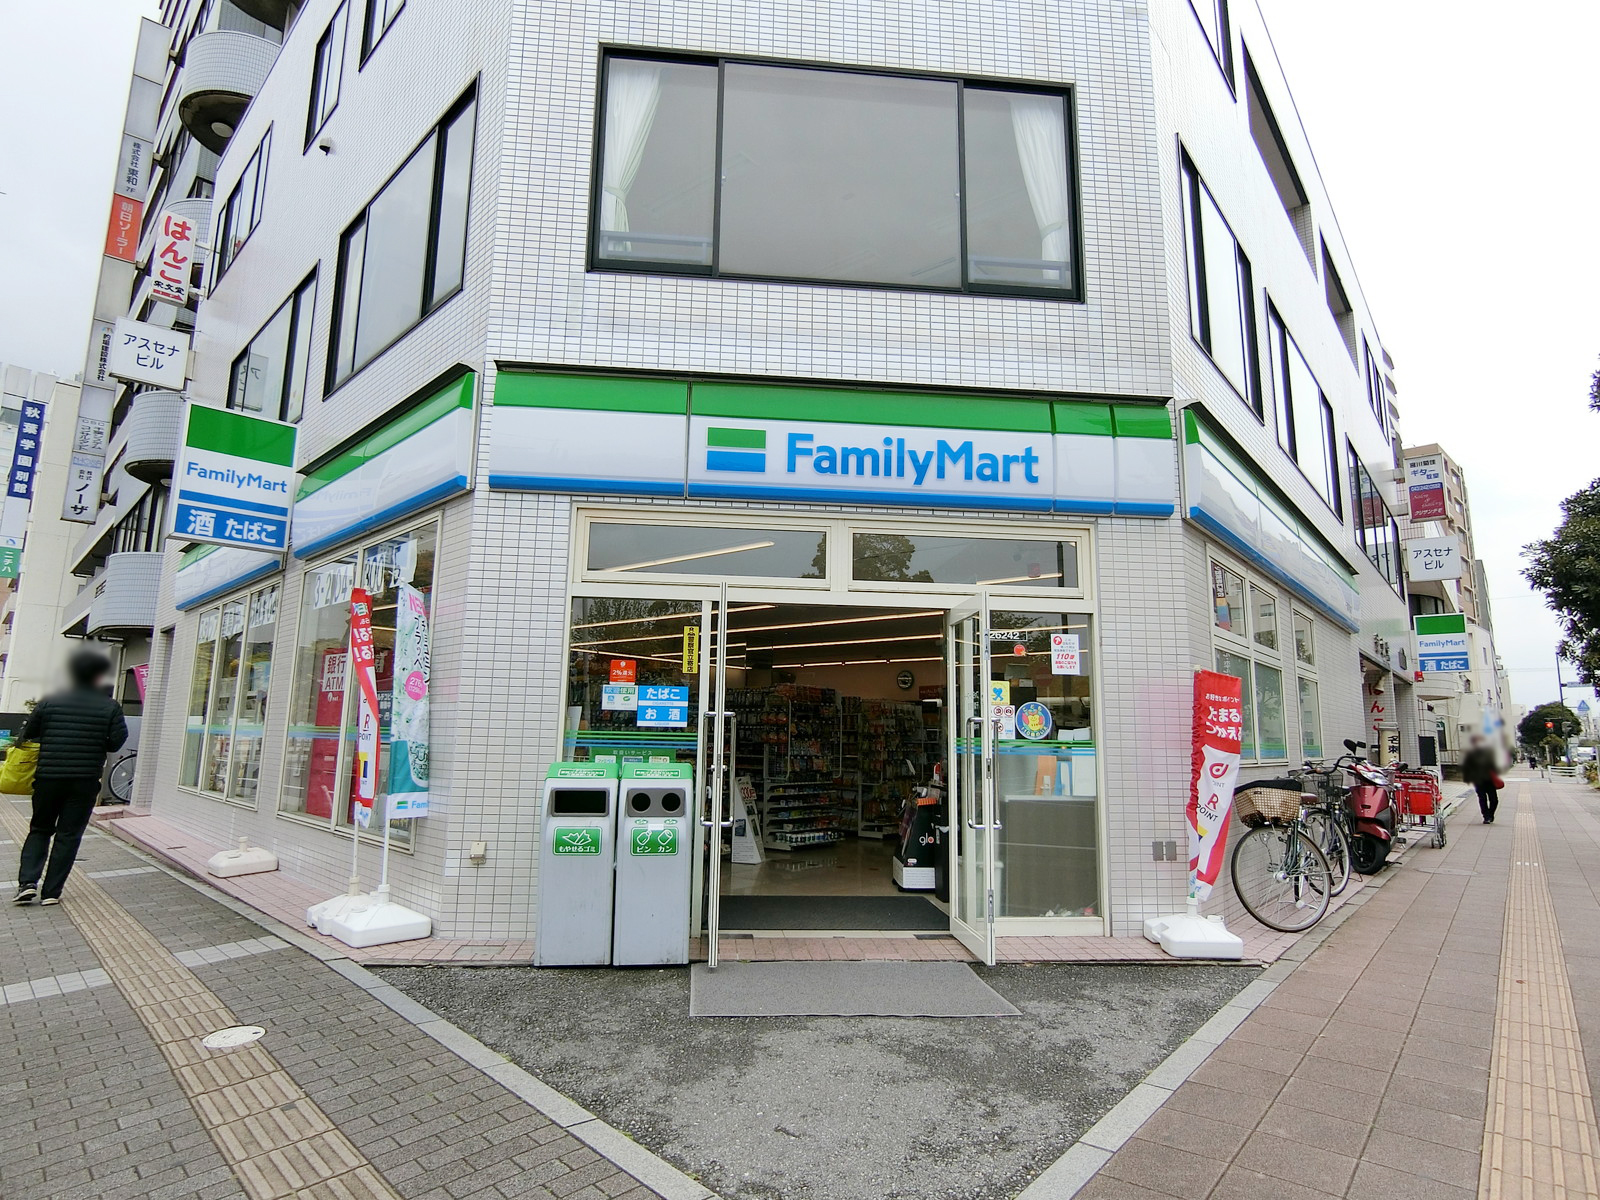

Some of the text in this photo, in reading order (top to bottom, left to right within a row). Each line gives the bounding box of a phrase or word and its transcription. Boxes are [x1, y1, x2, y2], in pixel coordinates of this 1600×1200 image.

[116, 203, 134, 254] 朝日ソーラー
[159, 215, 192, 284] はんこ
[123, 333, 180, 357] アスセナ
[136, 354, 164, 370] ビル
[786, 432, 1039, 486] FamilyMart
[186, 461, 288, 494] FamilyMart
[70, 483, 89, 515] ノーザ
[187, 508, 277, 544] 酒 たばこ
[3, 551, 14, 573] ニチハ
[1412, 548, 1453, 560] アスセナ
[1424, 560, 1444, 570] ビル
[1419, 639, 1465, 648] FamilyMart
[327, 655, 346, 674] 銀行
[1424, 660, 1465, 671] 酒 たばこ
[325, 676, 344, 690] ATM
[646, 688, 681, 700] たばこ
[645, 707, 681, 720] お 酒
[918, 832, 935, 846] glo
[558, 845, 596, 853] もやせるゴミ
